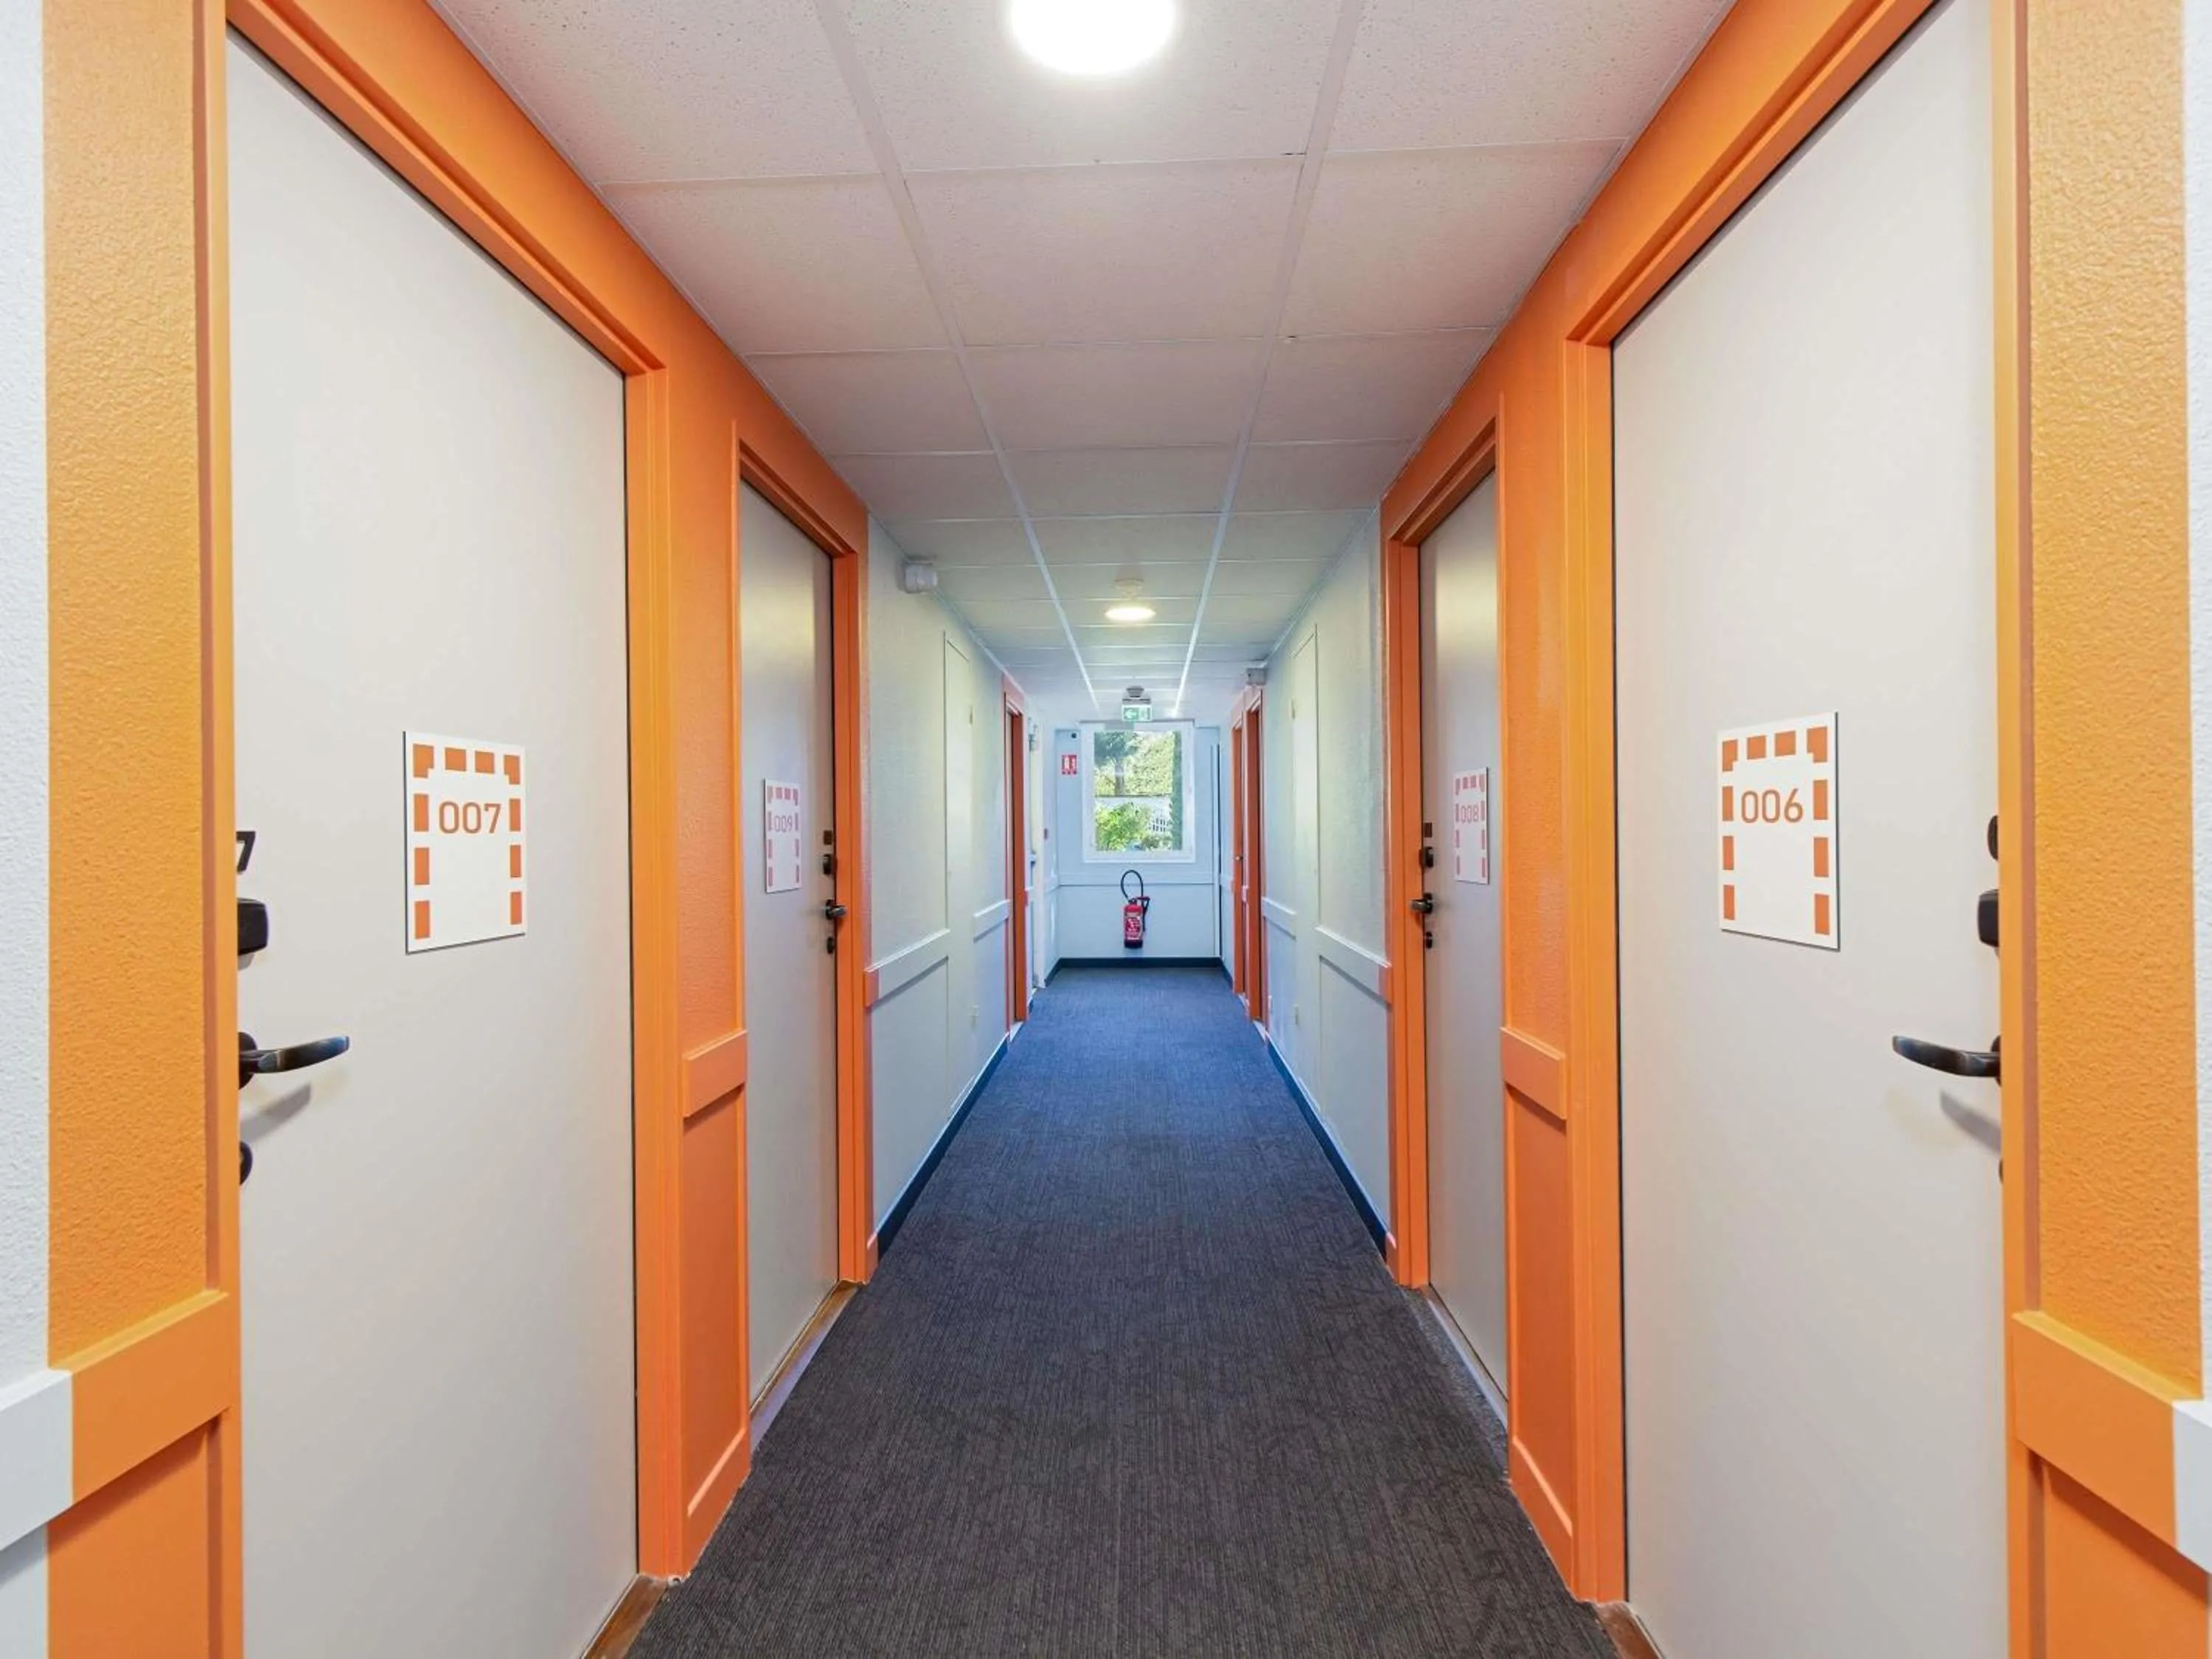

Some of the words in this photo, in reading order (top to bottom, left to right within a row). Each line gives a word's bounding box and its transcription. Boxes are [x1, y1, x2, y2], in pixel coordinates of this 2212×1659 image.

[439, 801, 501, 834] 007
[1461, 805, 1479, 824] 008
[1741, 788, 1804, 823] 006
[774, 815, 793, 833] 009
